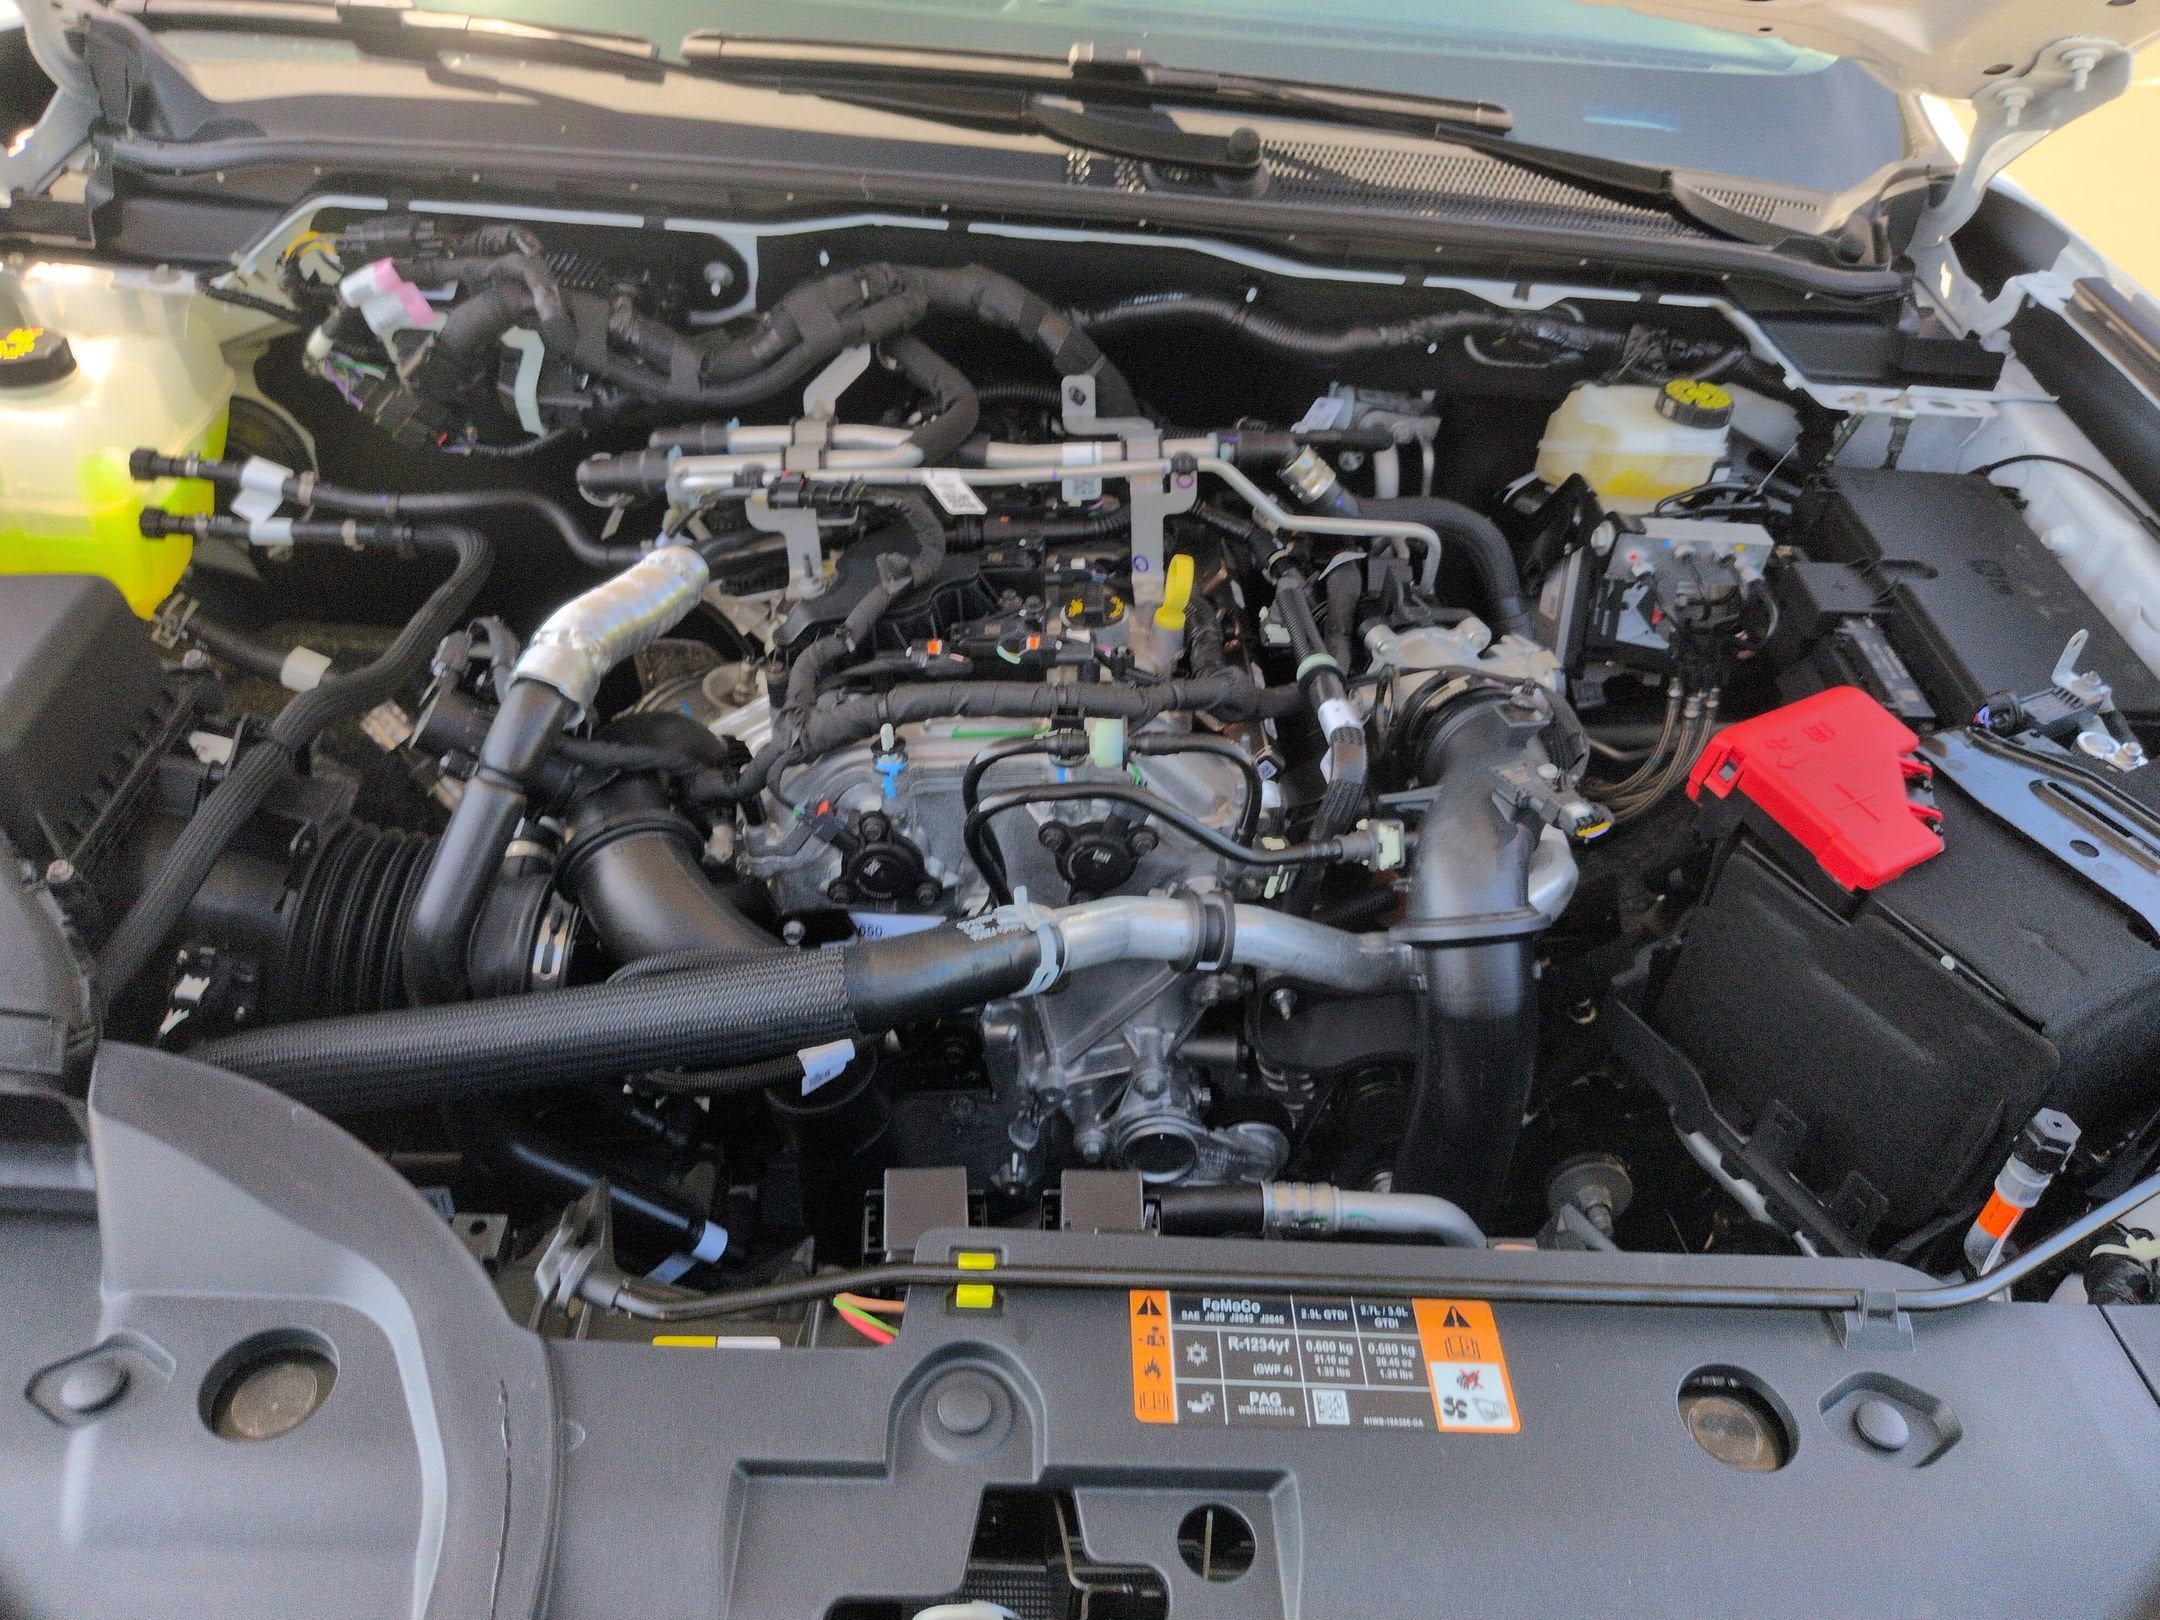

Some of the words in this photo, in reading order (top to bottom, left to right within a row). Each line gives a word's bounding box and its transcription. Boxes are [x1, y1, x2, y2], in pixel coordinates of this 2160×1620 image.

[1228, 1336, 1290, 1355] R-1234yf
[1339, 1341, 1354, 1356] kg
[1401, 1344, 1416, 1358] kg
[1249, 1391, 1281, 1407] PAG
